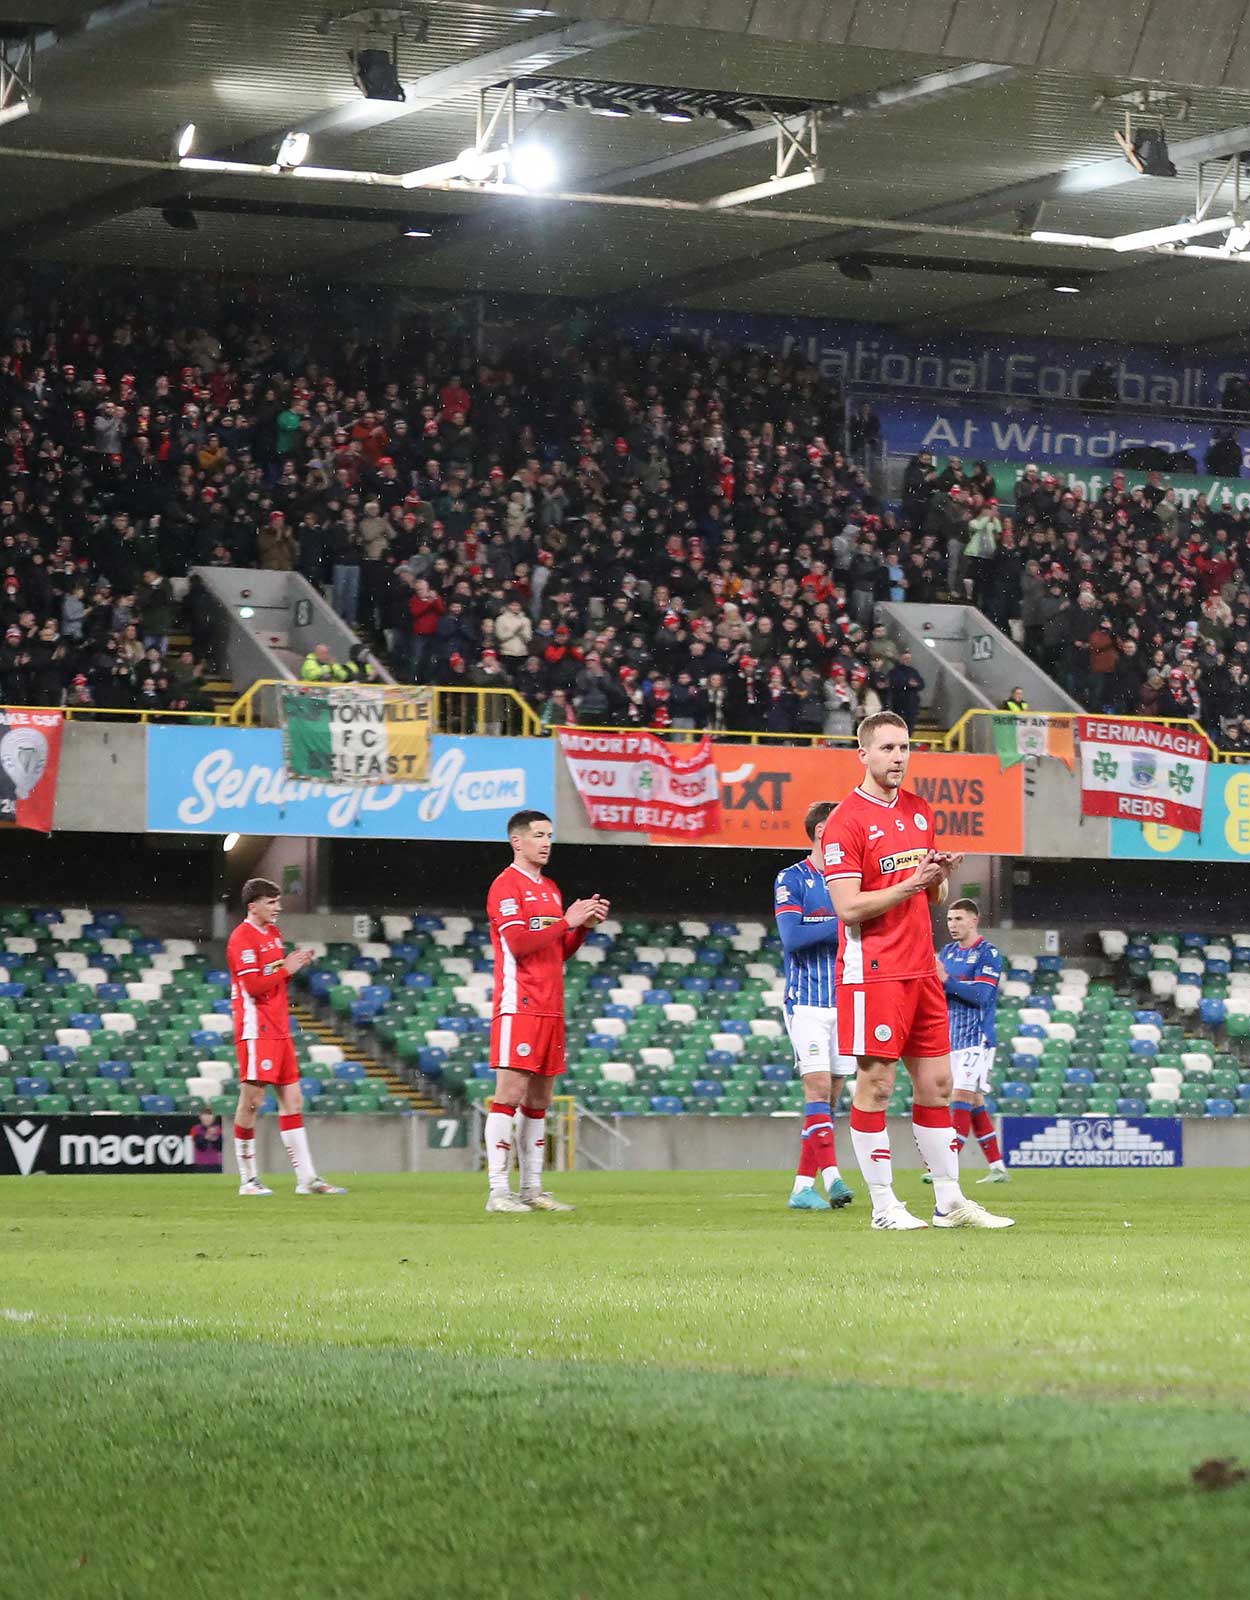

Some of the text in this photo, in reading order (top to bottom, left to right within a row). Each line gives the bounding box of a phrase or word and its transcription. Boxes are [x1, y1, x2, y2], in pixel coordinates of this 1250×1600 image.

[1005, 353, 1201, 407] Fooball
[922, 417, 979, 448] At
[295, 699, 428, 724] TONVILLE
[560, 733, 623, 754] MOOR
[1086, 721, 1201, 756] FERMANAGH
[577, 770, 616, 787] YOU
[913, 776, 985, 806] WAYS
[1118, 797, 1166, 819] REDS
[963, 1051, 981, 1068] 27
[437, 1119, 459, 1148] 7
[1071, 1120, 1114, 1151] RC
[1009, 1150, 1175, 1166] READY CONSTRUCTION
